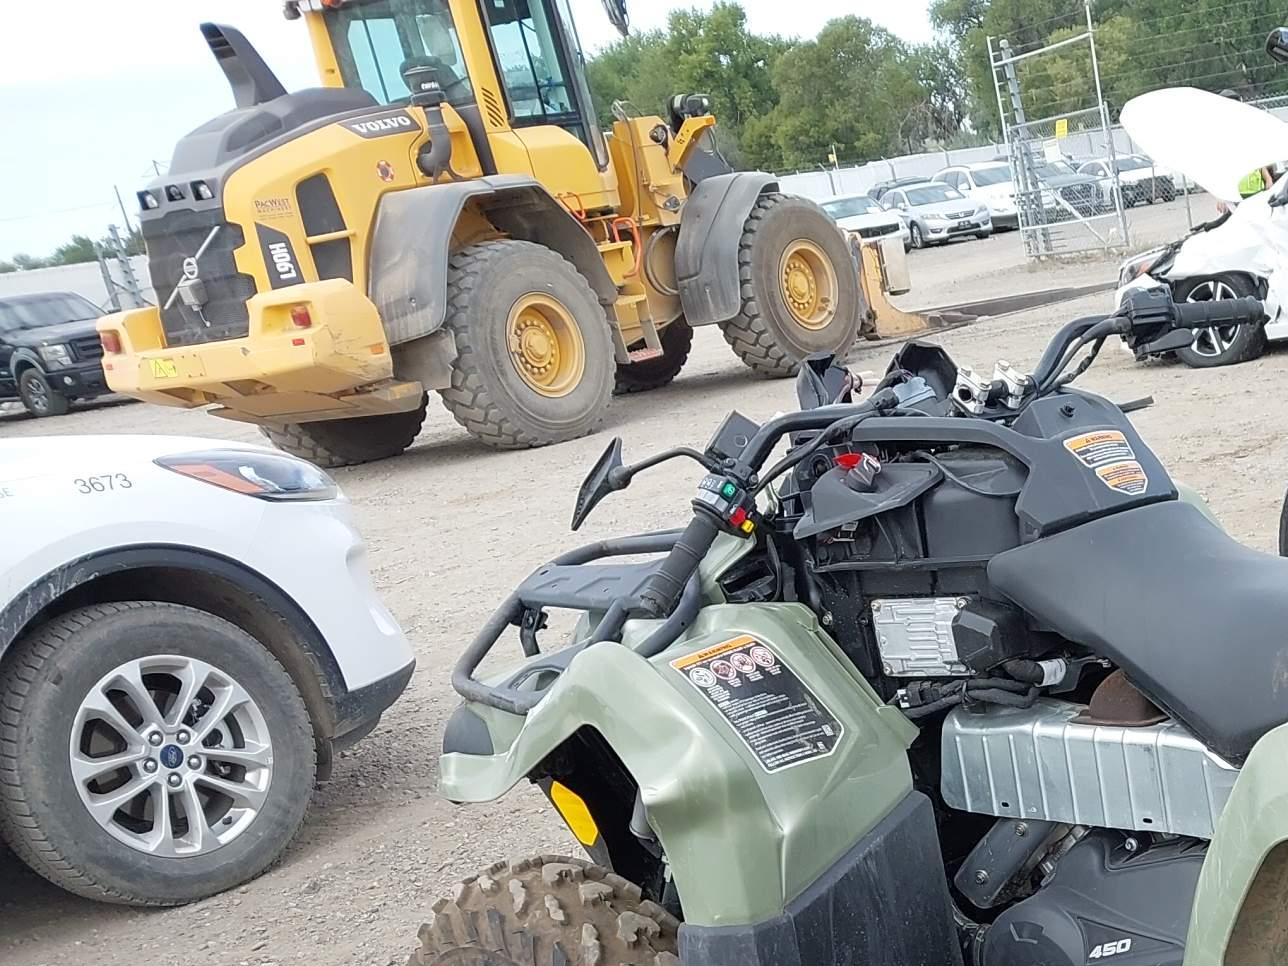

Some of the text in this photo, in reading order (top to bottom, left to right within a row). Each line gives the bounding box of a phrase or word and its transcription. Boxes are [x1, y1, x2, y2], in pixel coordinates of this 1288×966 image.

[351, 116, 411, 133] VOLVO
[268, 242, 297, 280] L90H
[73, 472, 132, 494] 3673
[1088, 938, 1132, 958] 450
